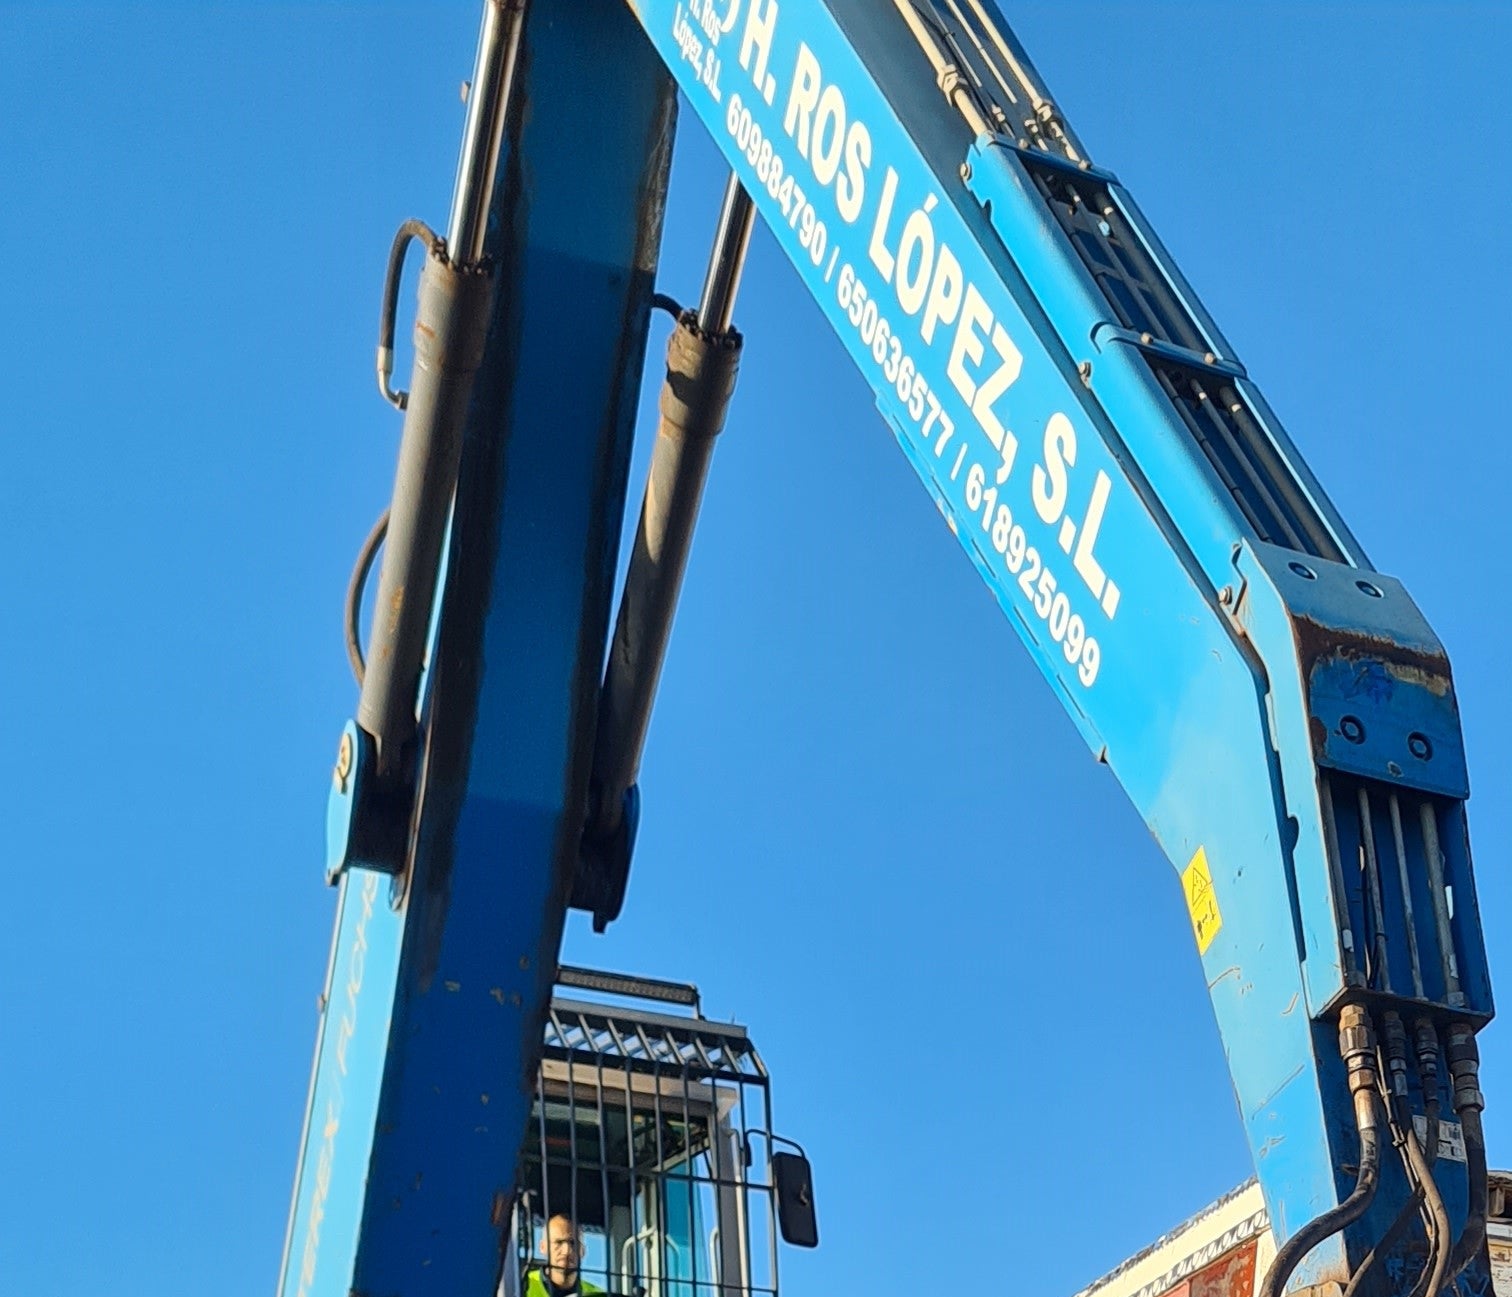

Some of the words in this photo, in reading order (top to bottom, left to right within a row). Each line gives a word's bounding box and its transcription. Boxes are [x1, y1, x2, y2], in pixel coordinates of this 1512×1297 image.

[701, 0, 722, 47] Ros
[727, 93, 827, 266] 609884790
[837, 263, 955, 457] 650636577
[965, 463, 1100, 687] 618925099
[783, 42, 872, 223] ROS
[868, 166, 1023, 485] LÓPEZ,
[1032, 412, 1120, 620] S.L.
